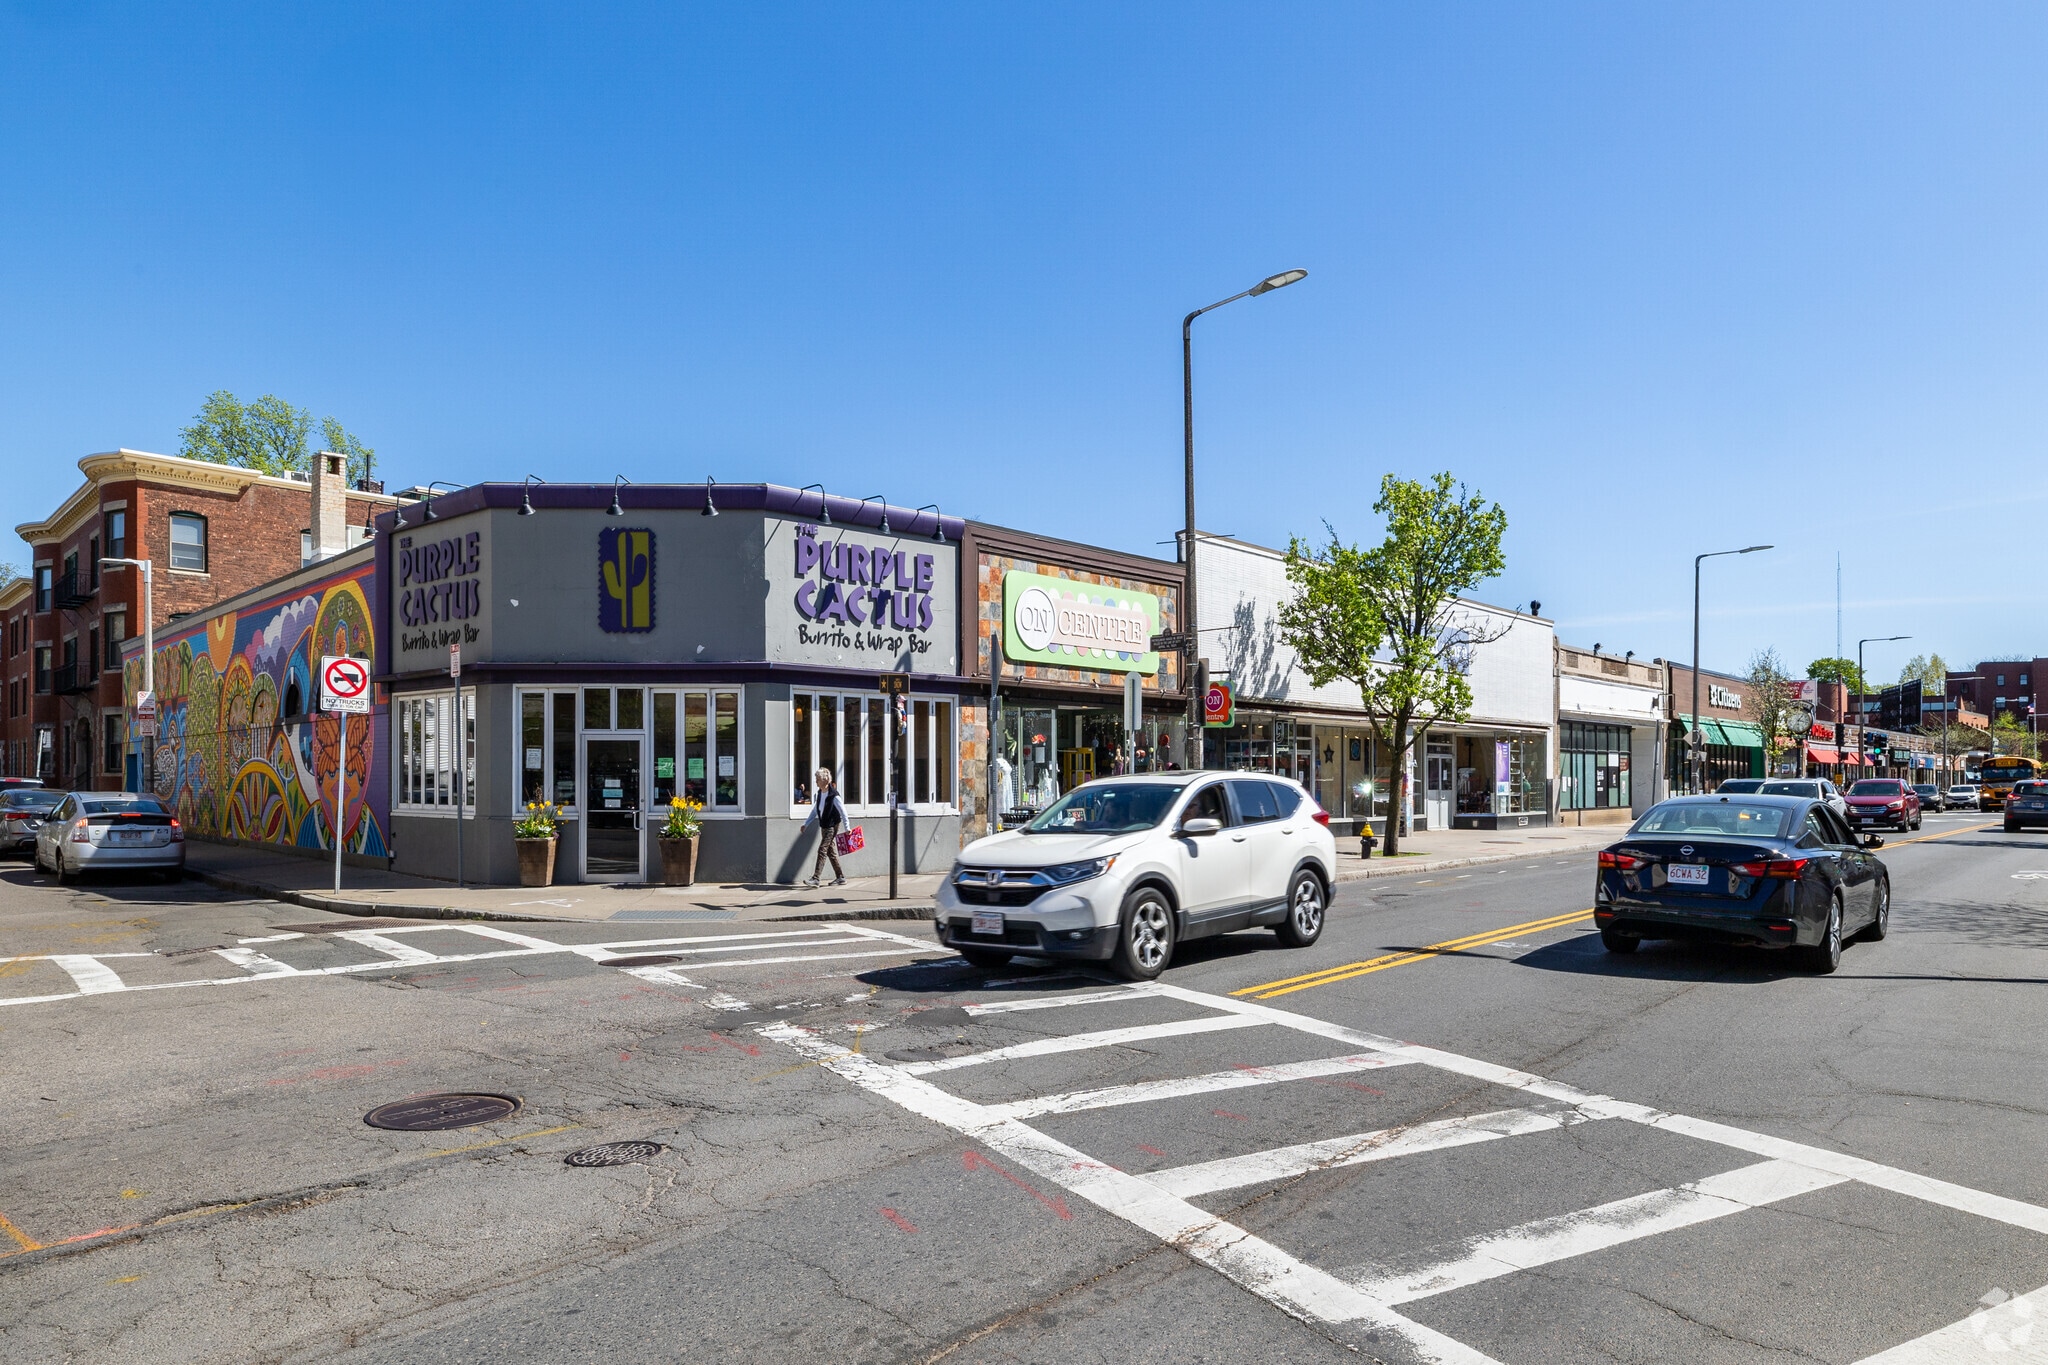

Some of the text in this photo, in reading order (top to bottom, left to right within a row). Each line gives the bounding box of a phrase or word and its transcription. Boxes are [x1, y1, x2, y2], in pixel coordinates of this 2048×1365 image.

[400, 537, 412, 549] THE
[797, 522, 819, 537] THE
[399, 532, 480, 588] PURPLE
[795, 535, 935, 592] PURPLE
[399, 578, 480, 627] CACTUS
[795, 578, 935, 632] CACTUS
[1020, 606, 1051, 634] ON
[1057, 608, 1143, 645] CENTRE
[401, 623, 480, 652] Burrito & Wrap Bar
[798, 623, 933, 659] Burrito & Wrap Bar
[339, 699, 365, 707] TRUCKS
[1206, 695, 1221, 705] ON
[1717, 686, 1741, 709] Citizens
[1669, 869, 1707, 880] 6CWA 32
